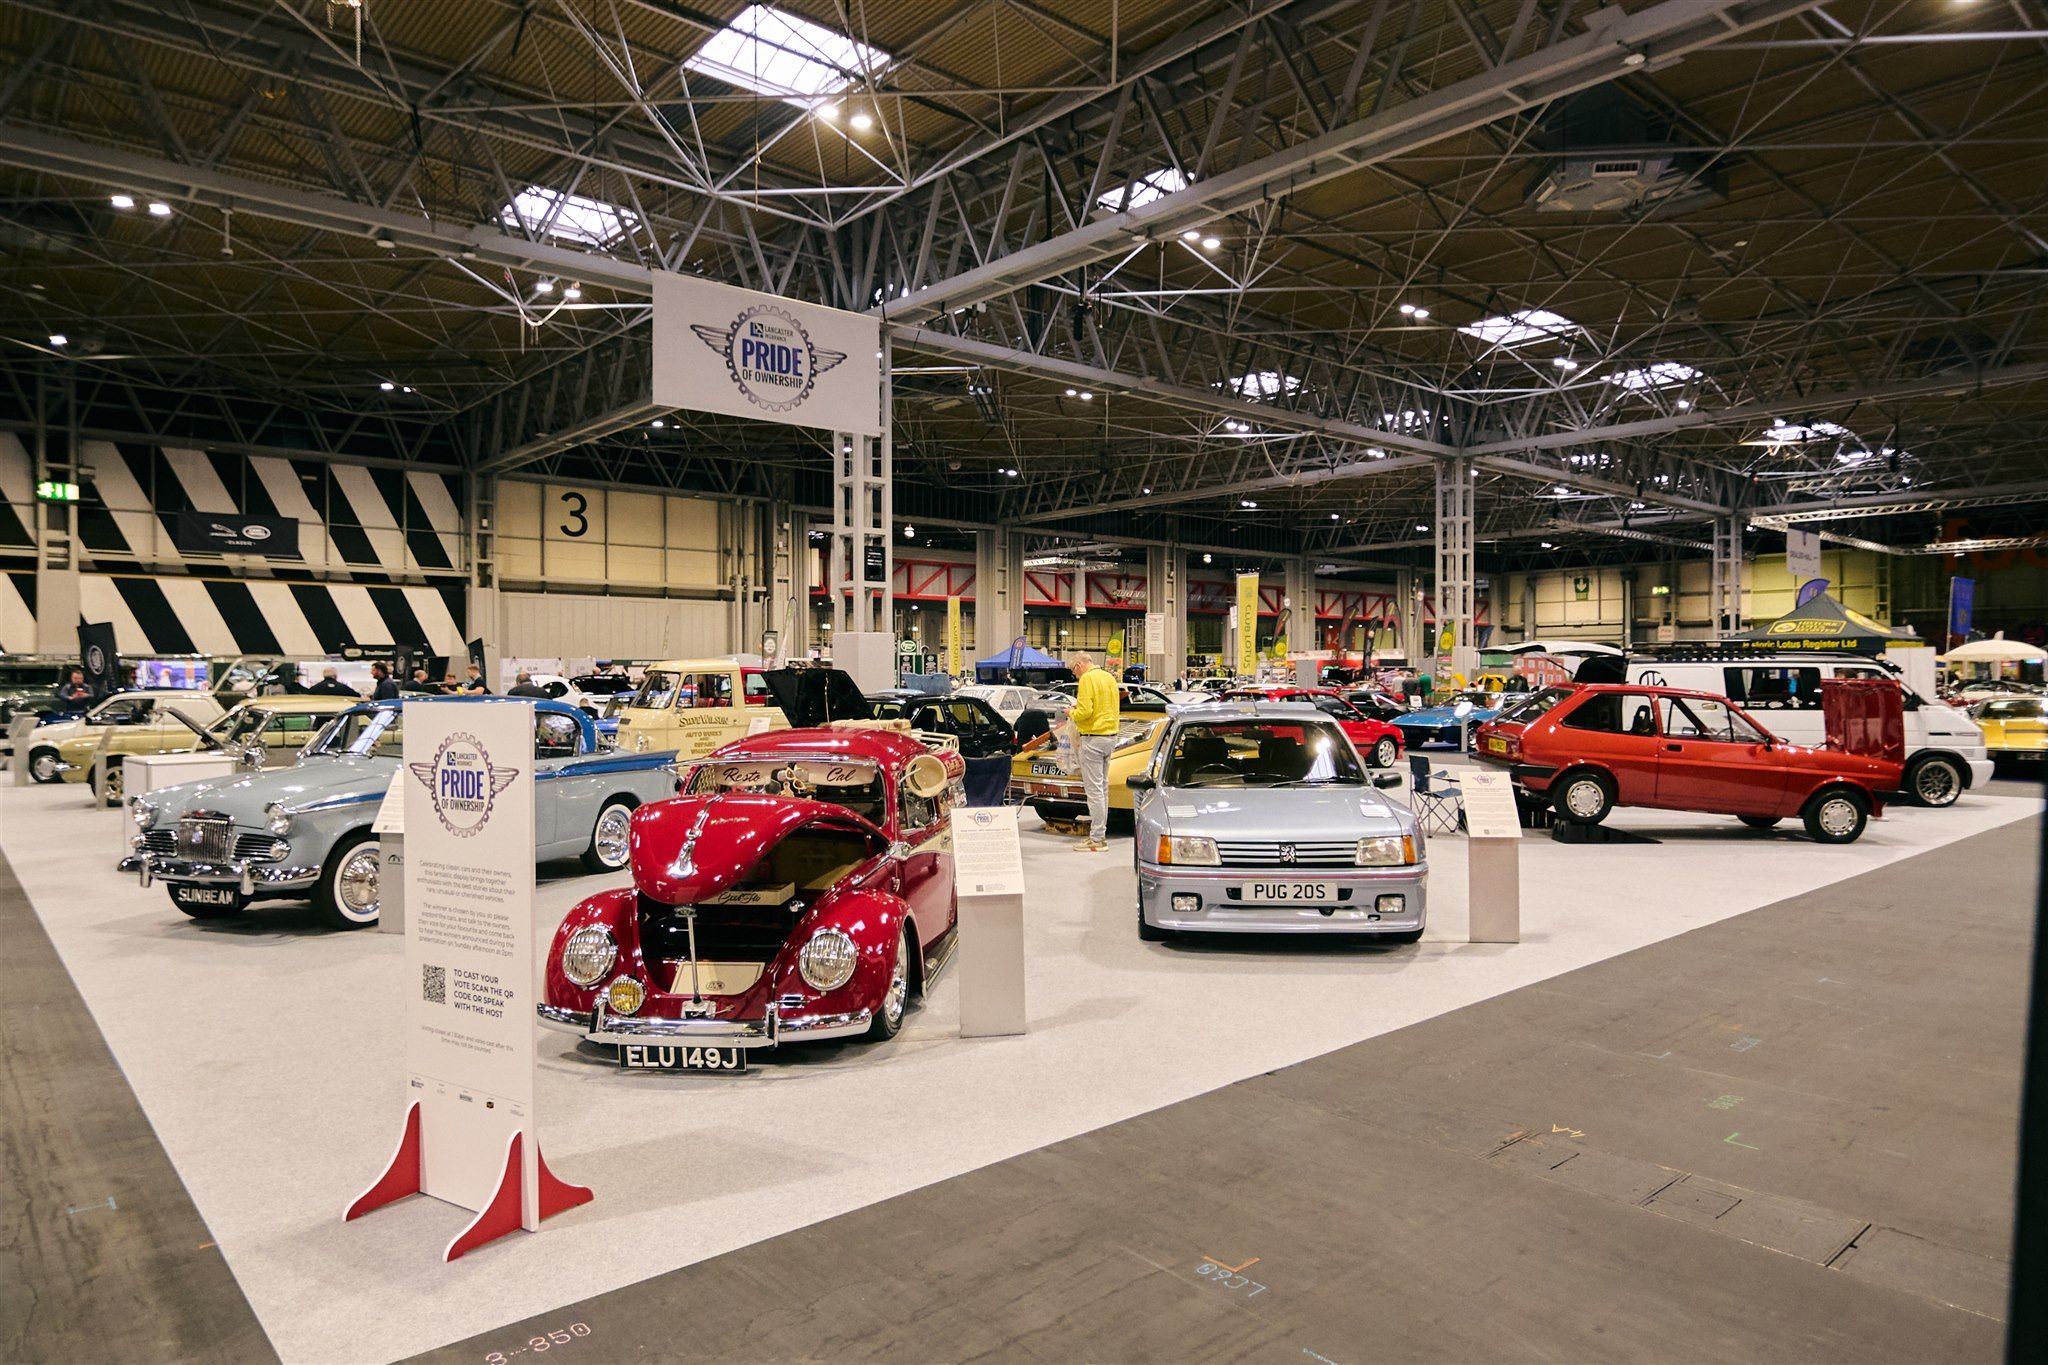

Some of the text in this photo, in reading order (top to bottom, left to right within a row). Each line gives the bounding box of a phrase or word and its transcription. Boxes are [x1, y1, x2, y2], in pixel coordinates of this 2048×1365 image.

[764, 326, 793, 336] LANCASTER
[742, 338, 803, 377] PRIDE
[742, 369, 804, 388] OF OWNERSHIP
[560, 492, 588, 537] 3
[1244, 636, 1252, 669] LOTUS
[1803, 640, 1840, 650] Register
[1841, 640, 1857, 648] Ltd
[723, 768, 857, 782] Resto Cal
[442, 769, 484, 800] PRIDE
[442, 799, 484, 812] OF OWNERSHIP
[420, 860, 446, 870] Celebrating
[417, 877, 442, 886] enthusiasts
[472, 884, 488, 892] stories
[434, 870, 452, 878] fantastic
[454, 873, 469, 881] display
[470, 875, 485, 884] brings
[486, 878, 506, 886] together
[178, 888, 234, 904] SUNBEAM
[437, 888, 454, 896] unusual
[462, 891, 484, 900] cherished
[1254, 884, 1326, 899] PUG 20S
[452, 906, 469, 915] chosen
[458, 924, 477, 933] favourite
[419, 936, 446, 944] presentation
[455, 942, 472, 950] Sunday
[472, 945, 495, 953] afternoon
[462, 934, 488, 944] announced
[489, 939, 505, 948] during
[454, 969, 498, 984] TO CAST YOUR
[454, 980, 514, 1000] VOTE SCAN THE QR
[454, 990, 504, 1007] CODE OR SPEAK
[454, 1002, 502, 1018] WITH THE HOST
[626, 1046, 738, 1068] ELU 149J
